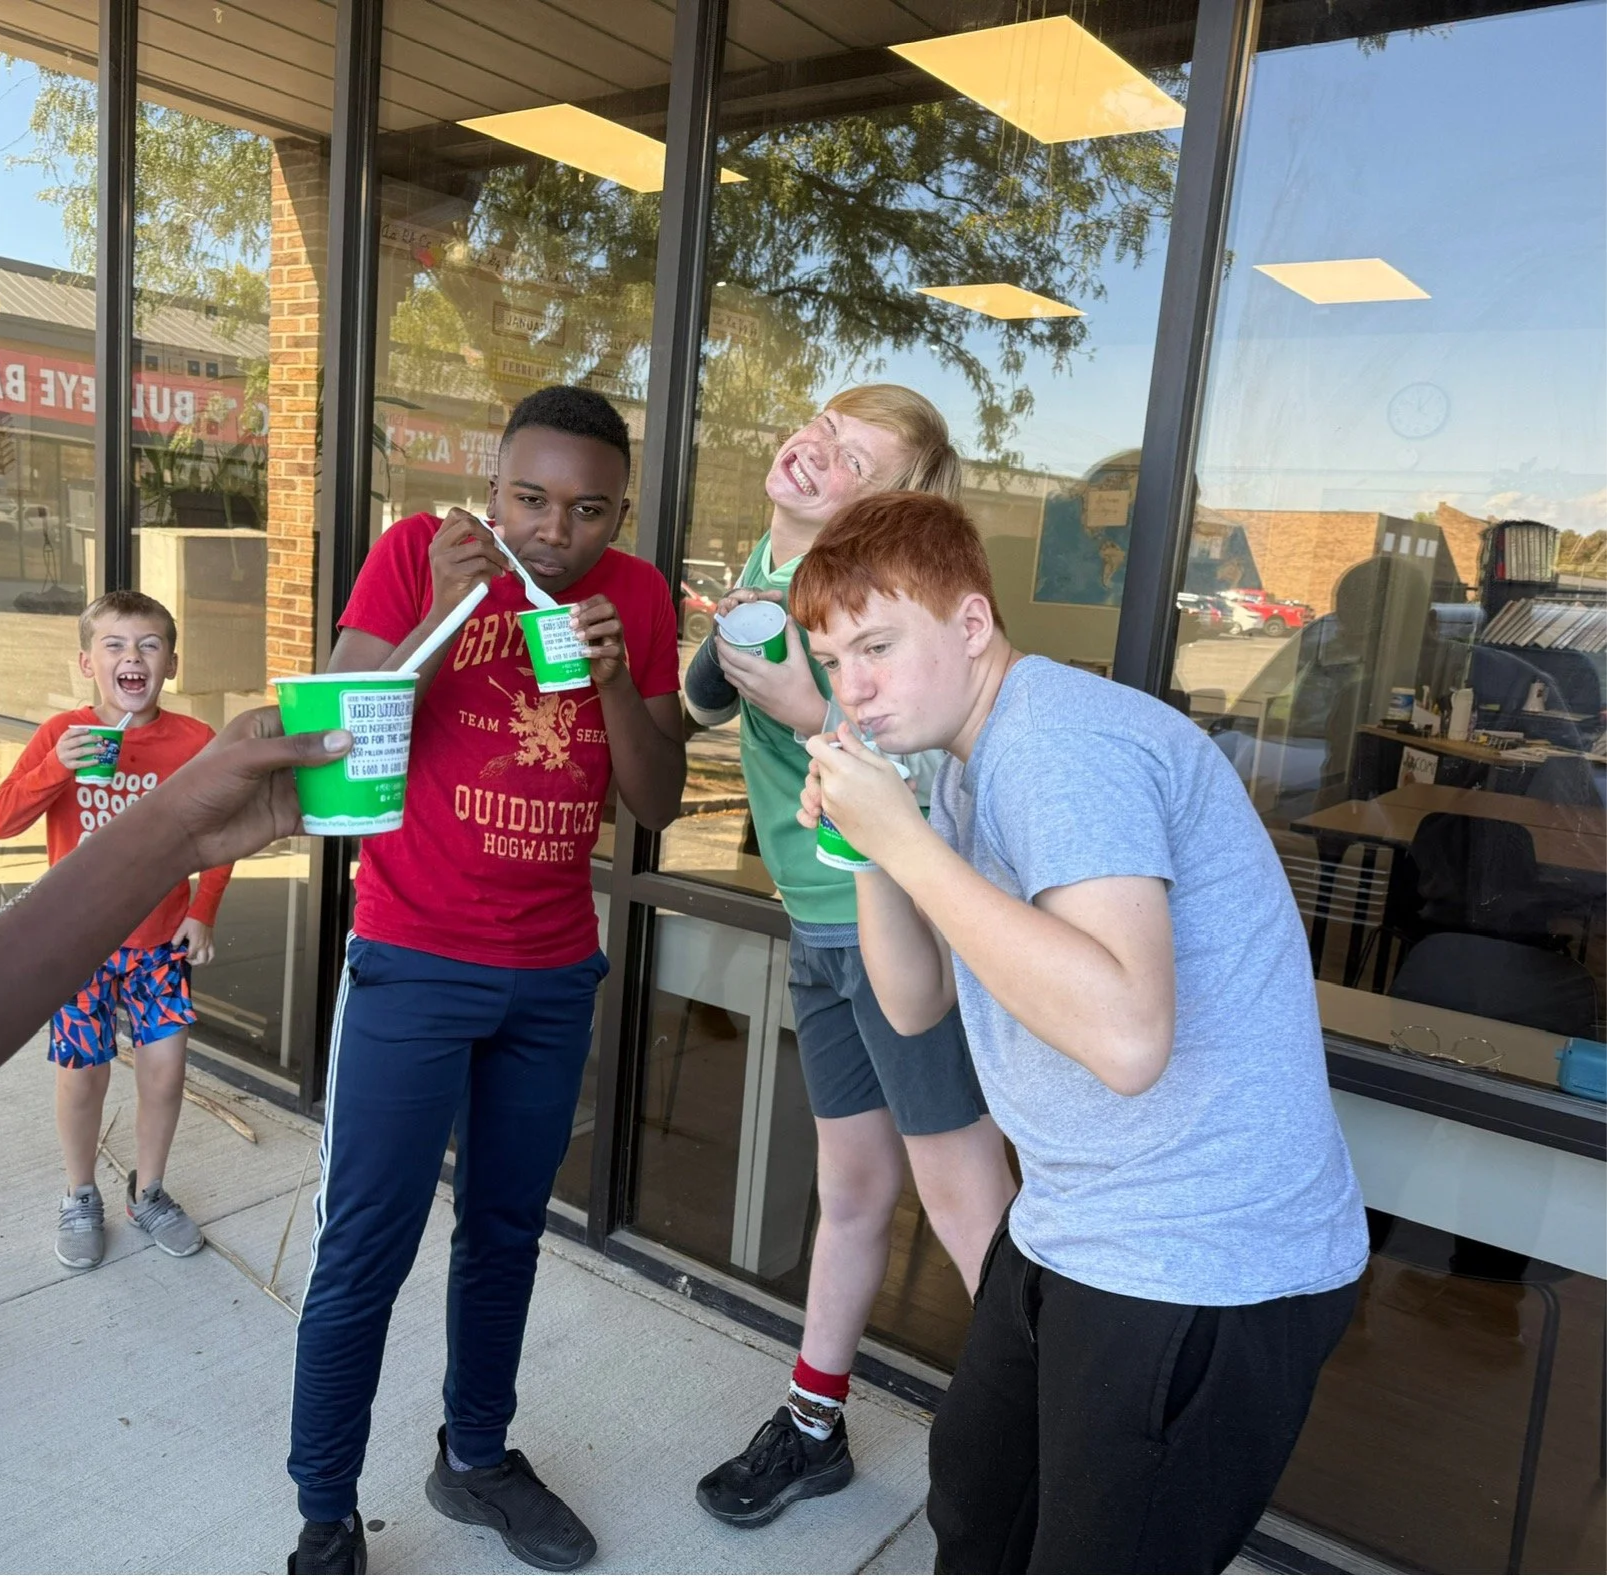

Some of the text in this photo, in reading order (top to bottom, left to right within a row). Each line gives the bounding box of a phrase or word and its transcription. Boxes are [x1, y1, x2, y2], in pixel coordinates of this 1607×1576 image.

[348, 703, 376, 719] THIS
[377, 701, 404, 718] LITTLE
[350, 724, 367, 734] GOOD
[459, 710, 608, 744] TEAM SEEK
[371, 734, 384, 744] FOR
[387, 733, 397, 744] THE
[362, 764, 378, 775] GOOD
[454, 784, 599, 835] QUIDDITCH
[483, 832, 575, 862] HOGWARTS
